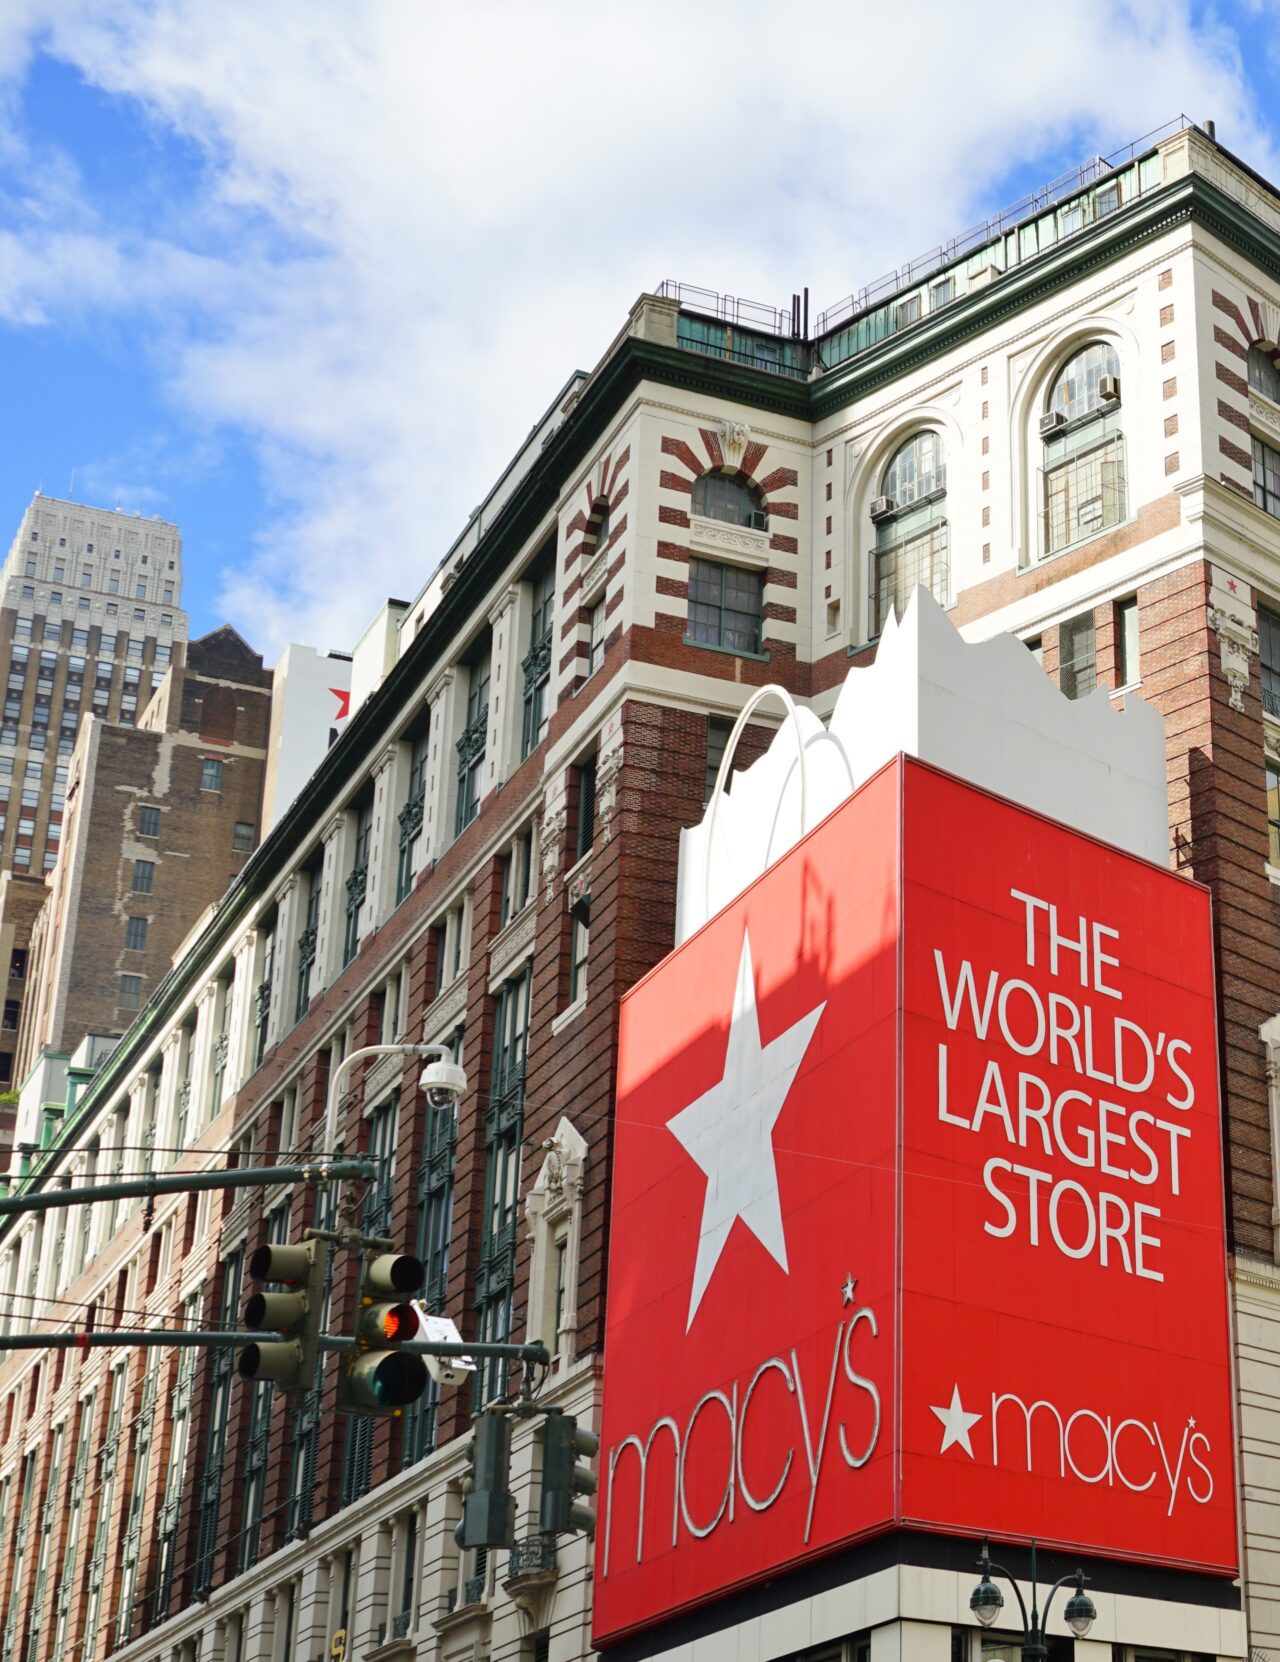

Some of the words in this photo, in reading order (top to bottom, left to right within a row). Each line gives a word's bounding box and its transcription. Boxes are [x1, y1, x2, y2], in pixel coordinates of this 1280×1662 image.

[1010, 888, 1123, 1000] THE
[933, 949, 1195, 1110] WORLD'S
[938, 1043, 1191, 1196] LARGEST
[983, 1157, 1164, 1282] STORE
